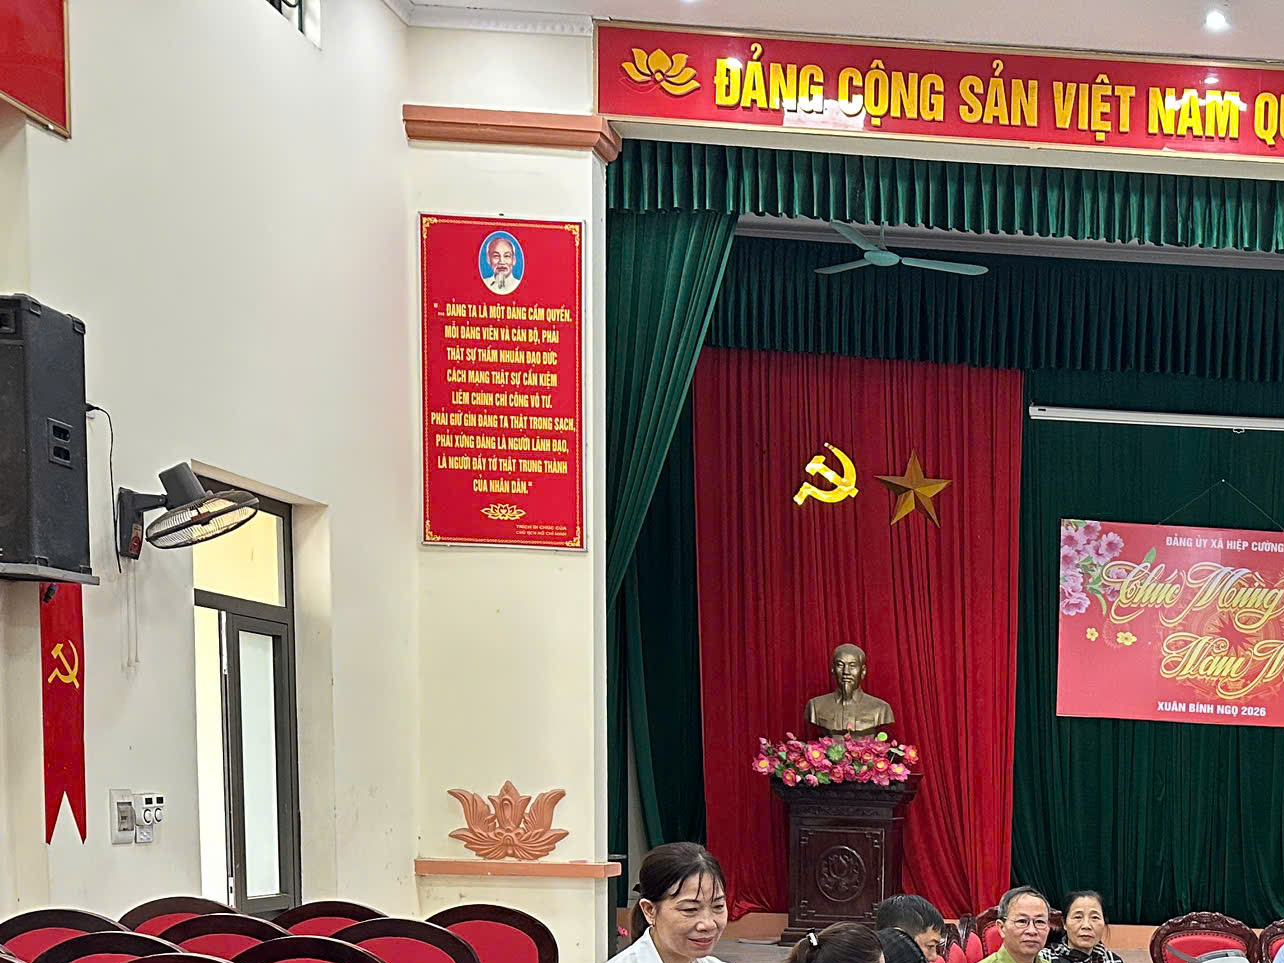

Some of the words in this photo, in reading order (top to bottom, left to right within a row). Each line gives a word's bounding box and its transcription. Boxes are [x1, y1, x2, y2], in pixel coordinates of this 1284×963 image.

[714, 43, 824, 114] ĐẢNG
[838, 59, 944, 126] CỘNG
[960, 60, 1038, 128] SẢN
[1052, 74, 1136, 142] VIỆT
[1148, 86, 1242, 140] NAM
[446, 298, 466, 317] ĐẢNG
[468, 305, 477, 317] TA
[479, 303, 488, 318] LÀ
[489, 297, 505, 321] MỘT
[507, 302, 526, 320] ĐẢNG
[461, 321, 480, 339] ĐẢNG
[482, 325, 498, 340] VIÊN
[500, 326, 510, 341] VÀ
[512, 326, 526, 342] CÁN
[542, 325, 559, 343] PHẢI
[447, 345, 464, 363] THẬT
[466, 348, 476, 364] SỰ
[478, 345, 498, 362] THẤM
[526, 351, 541, 366] ĐẠO
[543, 349, 557, 365] ĐỨC
[447, 368, 466, 382] CÁCH
[468, 370, 489, 385] MẠNG
[491, 369, 509, 387] THẬT
[511, 372, 521, 387] SỰ
[539, 371, 557, 389] KIỆM
[452, 389, 469, 404] LIÊM
[472, 391, 493, 405] CHÍNH
[495, 392, 507, 406] CHÍ
[509, 392, 528, 407] CÔNG
[530, 393, 540, 408] VÔ
[431, 408, 448, 425] PHẢI
[450, 410, 463, 426] GIỮ
[464, 412, 476, 426] GÌN
[478, 410, 498, 427] ĐẢNG
[499, 415, 508, 428] TA
[510, 414, 527, 431] THẬT
[529, 417, 552, 430] TRONG
[436, 429, 453, 447] PHẢI
[455, 432, 474, 448] XỨNG
[476, 434, 496, 449] ĐÁNG
[498, 435, 506, 449] LÀ
[508, 435, 530, 450] NGƯỜI
[532, 436, 550, 451] LÃNH
[438, 456, 447, 468] LÀ
[449, 454, 470, 469] NGƯỜI
[488, 455, 497, 471] TỚ
[499, 457, 516, 474] THẬT
[519, 459, 542, 472] TRUNG
[544, 458, 567, 473] THÀNH
[474, 474, 488, 492] CỦA
[490, 478, 509, 493] NHÂN
[1166, 533, 1193, 547] ĐẢNG
[1195, 534, 1208, 548] ỦY
[1210, 537, 1224, 549] XÃ
[1226, 538, 1249, 552] HIỆP
[1251, 540, 1284, 553] CƯỜNG
[1102, 561, 1185, 624] Chúc
[1160, 632, 1253, 680] Năm
[1157, 701, 1186, 712] XUÂN
[1189, 701, 1214, 714] BÍNH
[1216, 705, 1239, 717] NGỌ
[1241, 706, 1266, 717] 2026
